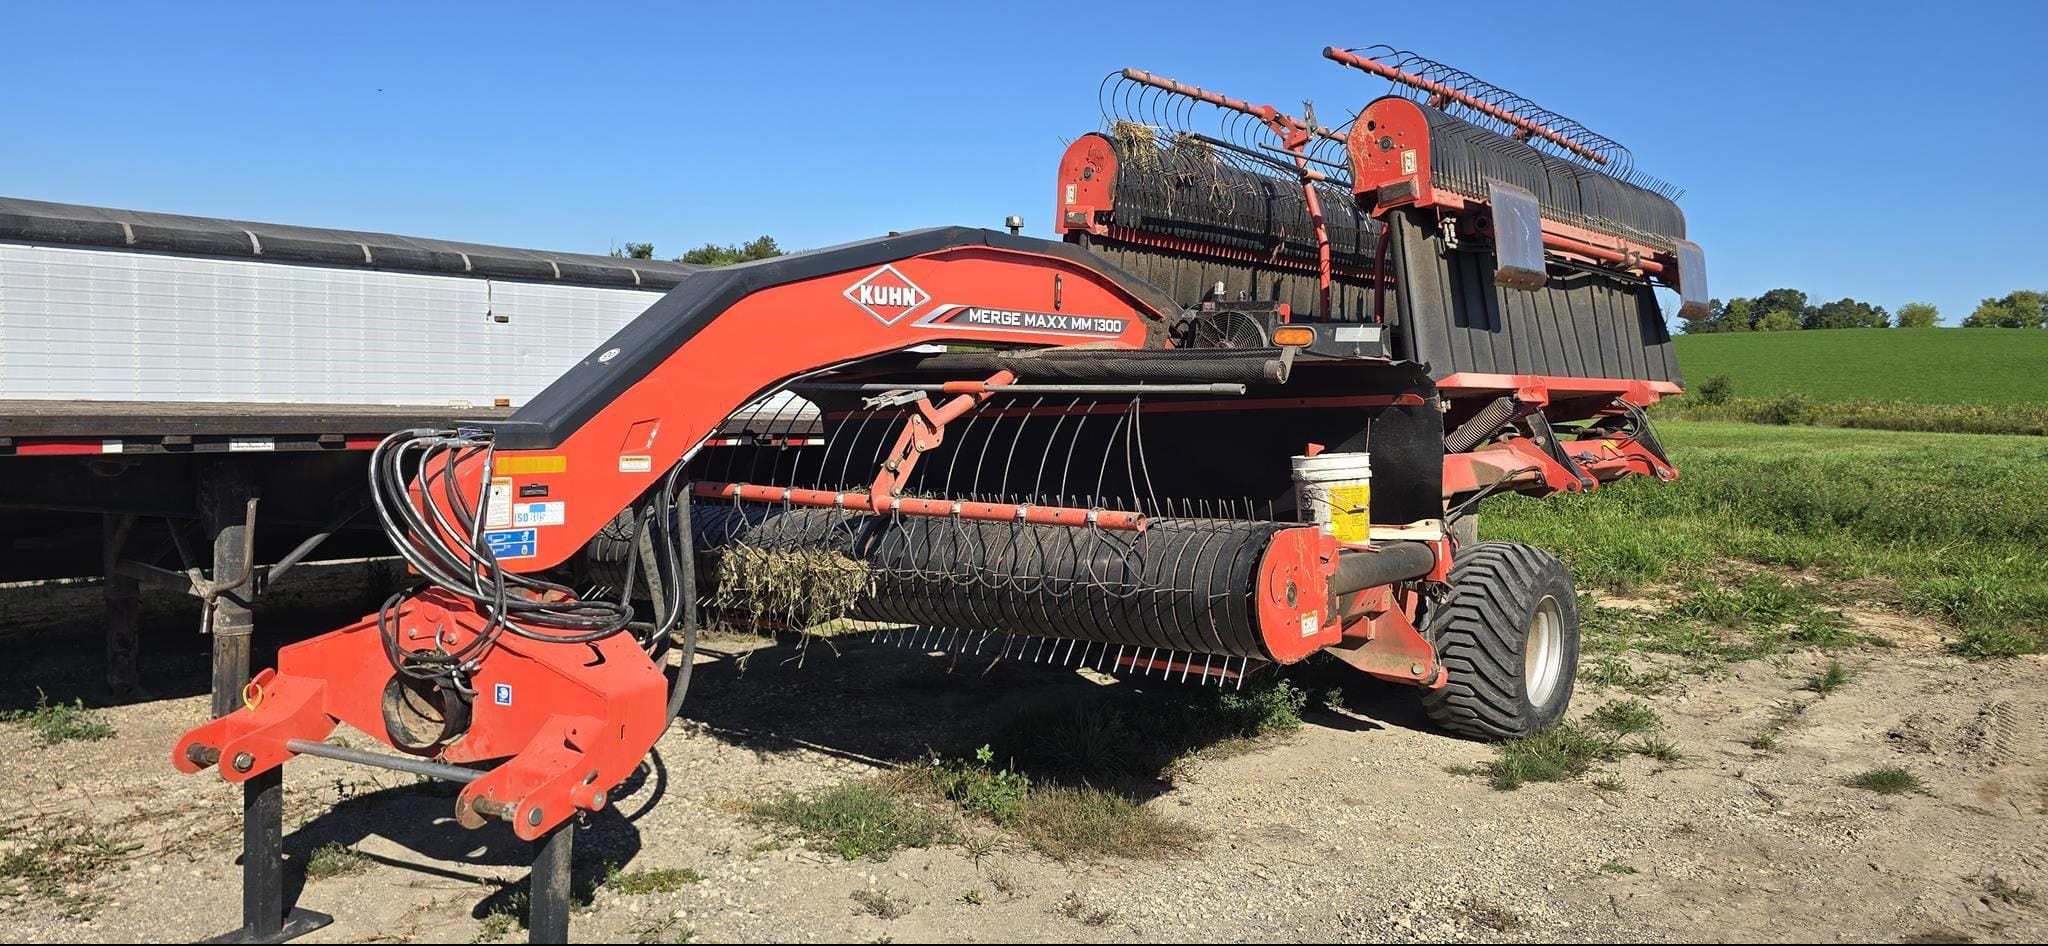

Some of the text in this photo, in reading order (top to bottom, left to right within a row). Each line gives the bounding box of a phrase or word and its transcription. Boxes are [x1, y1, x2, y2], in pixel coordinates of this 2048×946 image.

[860, 285, 916, 307] KUHN
[969, 309, 1122, 333] MERGE MAXX MM 1300
